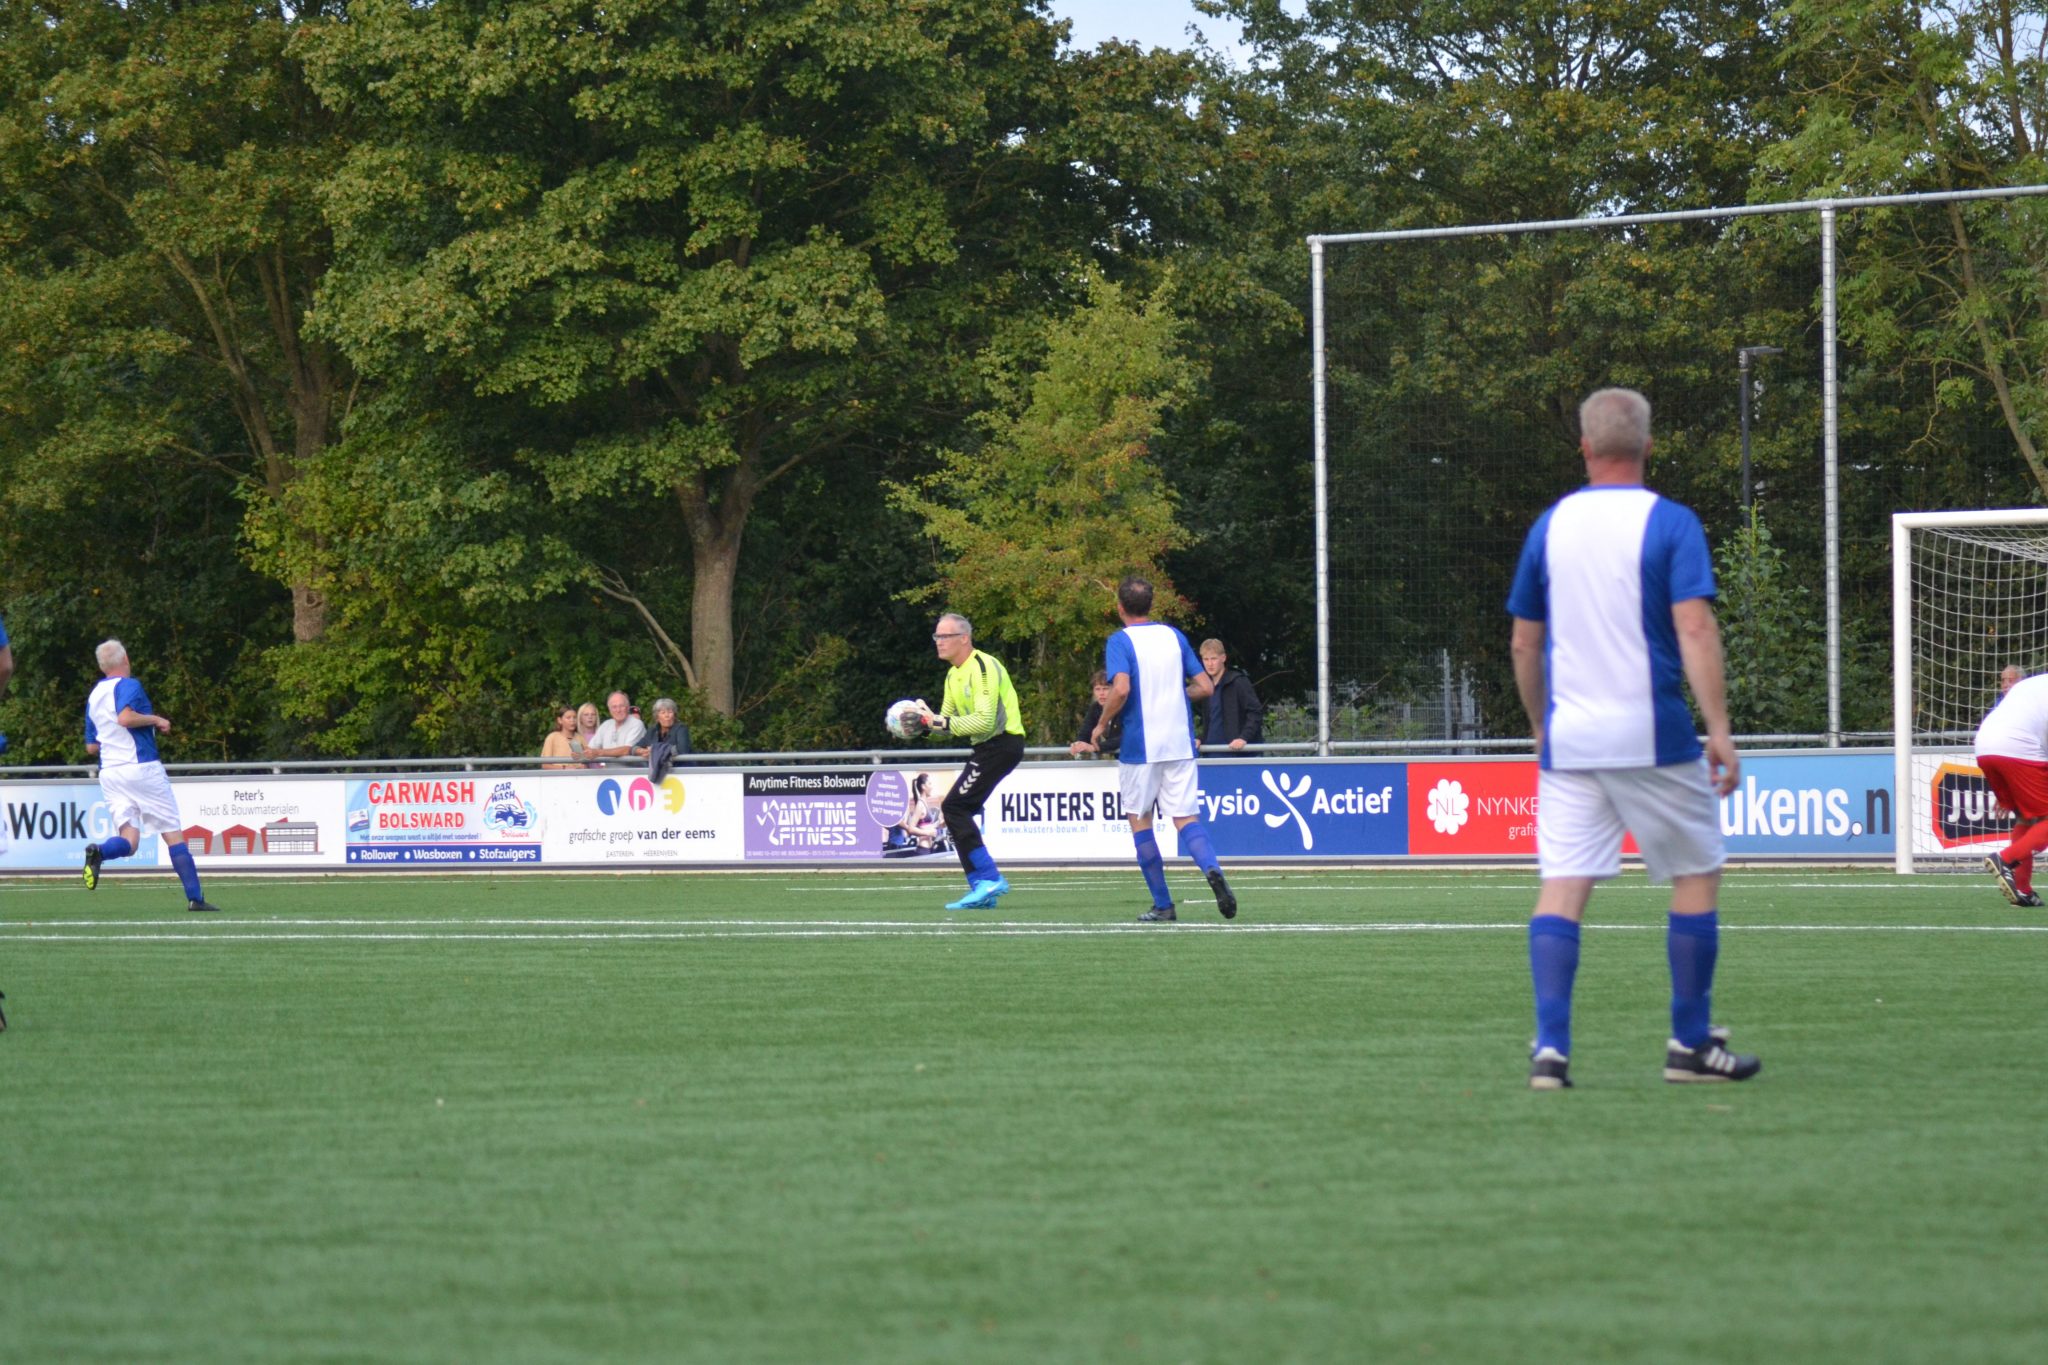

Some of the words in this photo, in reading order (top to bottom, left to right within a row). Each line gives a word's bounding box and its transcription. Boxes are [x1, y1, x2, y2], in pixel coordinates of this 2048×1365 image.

[494, 781, 511, 793] CAR
[749, 776, 788, 792] Anytime
[790, 776, 822, 789] Fitness
[824, 774, 866, 788] Bolsward
[234, 788, 264, 801] Peter's
[368, 781, 475, 805] CARWASH
[491, 789, 515, 803] WASH
[1312, 786, 1392, 815] Actief
[200, 804, 220, 816] Hout
[222, 804, 229, 816] &
[231, 803, 299, 816] Bouwmaterialen
[778, 801, 857, 826] ANYTIME
[1001, 791, 1095, 822] KUSTERS
[1435, 797, 1461, 816] NL
[1477, 796, 1540, 816] NYNKE
[1719, 775, 1896, 838] ukens.n
[8, 801, 154, 840] WolkG
[379, 812, 464, 829] BOLSWARD
[569, 828, 606, 844] grafische
[609, 830, 634, 844] groep
[637, 830, 657, 840] van
[661, 828, 681, 840] der
[685, 829, 716, 840] eems
[779, 826, 857, 846] FITNESS
[1508, 822, 1540, 840] grafis
[361, 849, 399, 860] Rollover
[413, 849, 463, 860] Wasboxen
[479, 848, 536, 862] Stofzuigers
